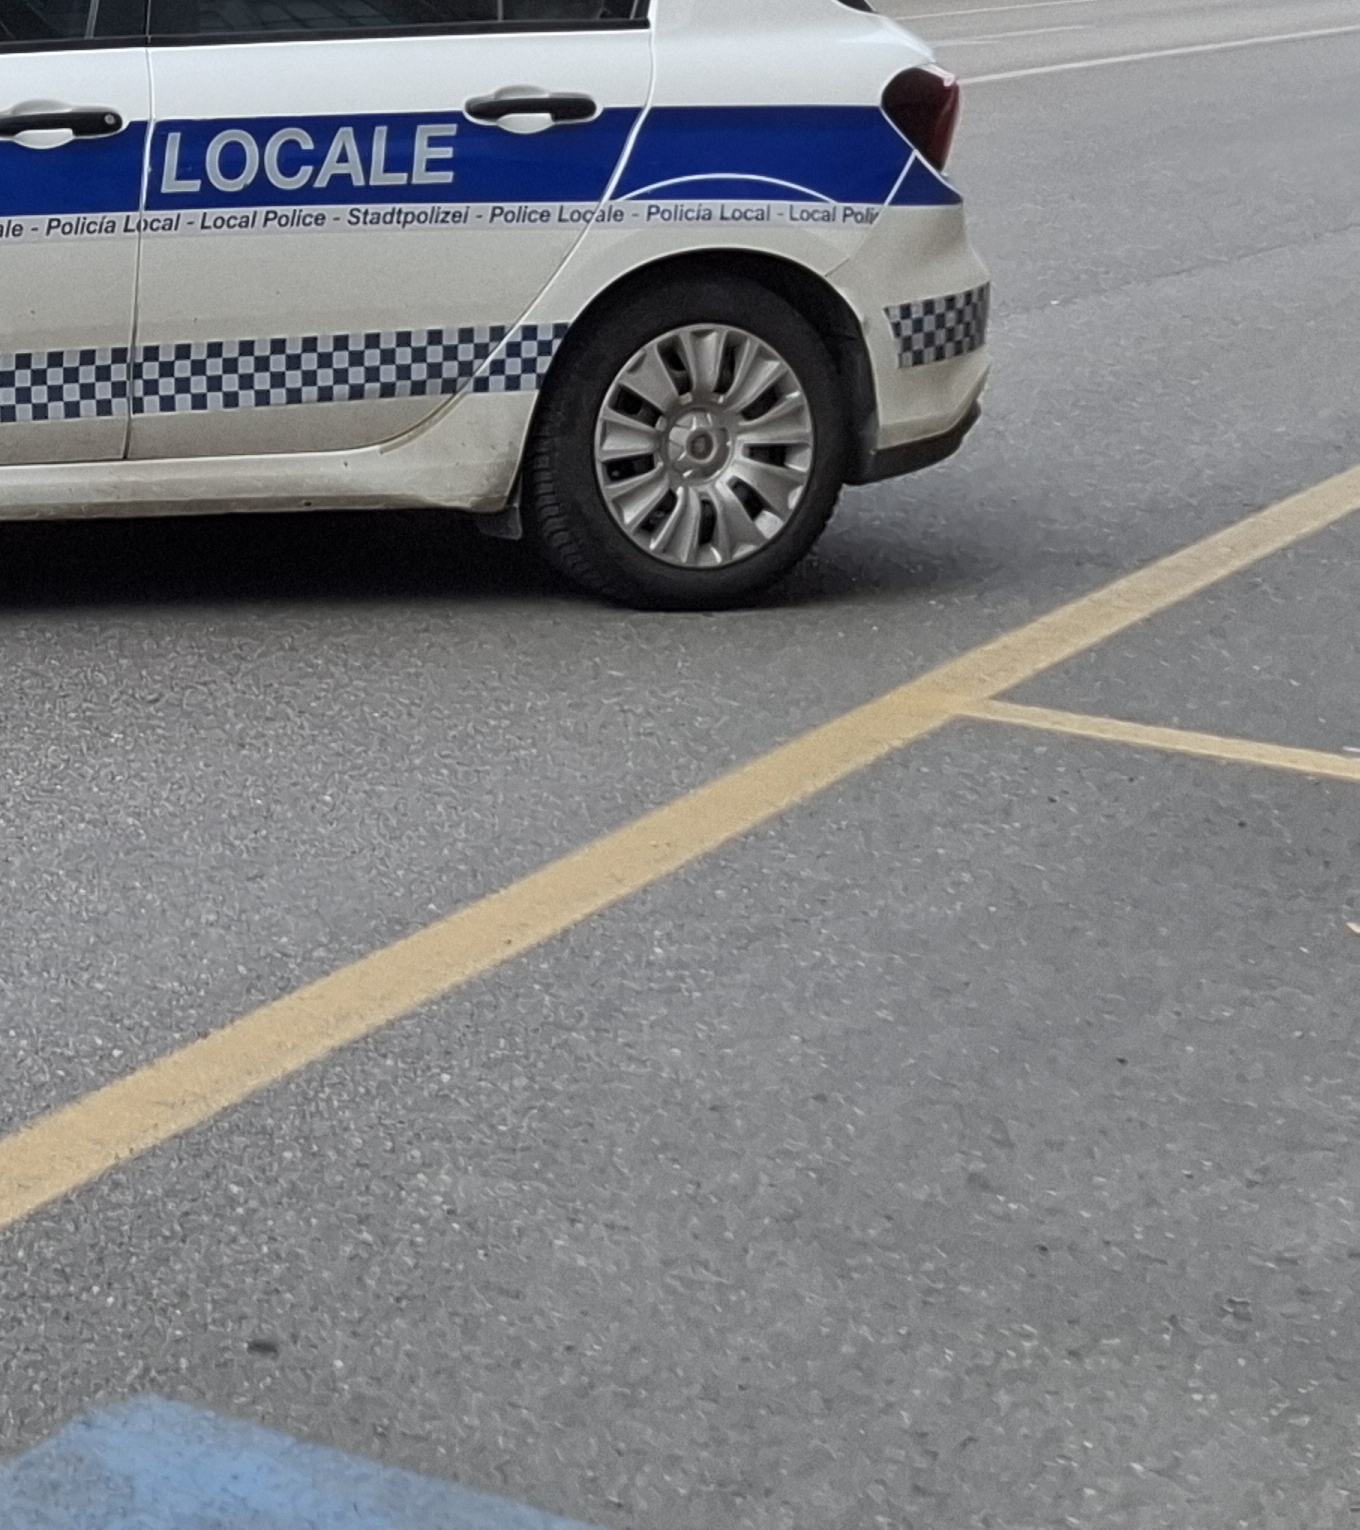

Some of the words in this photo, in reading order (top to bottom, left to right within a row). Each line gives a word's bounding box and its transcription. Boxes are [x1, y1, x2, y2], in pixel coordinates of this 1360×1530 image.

[160, 123, 458, 194] LOCALE
[122, 212, 180, 234] Local
[199, 211, 257, 230] Local
[261, 208, 326, 229] Police
[347, 206, 471, 229] Stadtpolizei
[488, 204, 551, 224] Police
[557, 204, 625, 224] Locale
[719, 204, 772, 222] Local
[789, 205, 838, 223] Local
